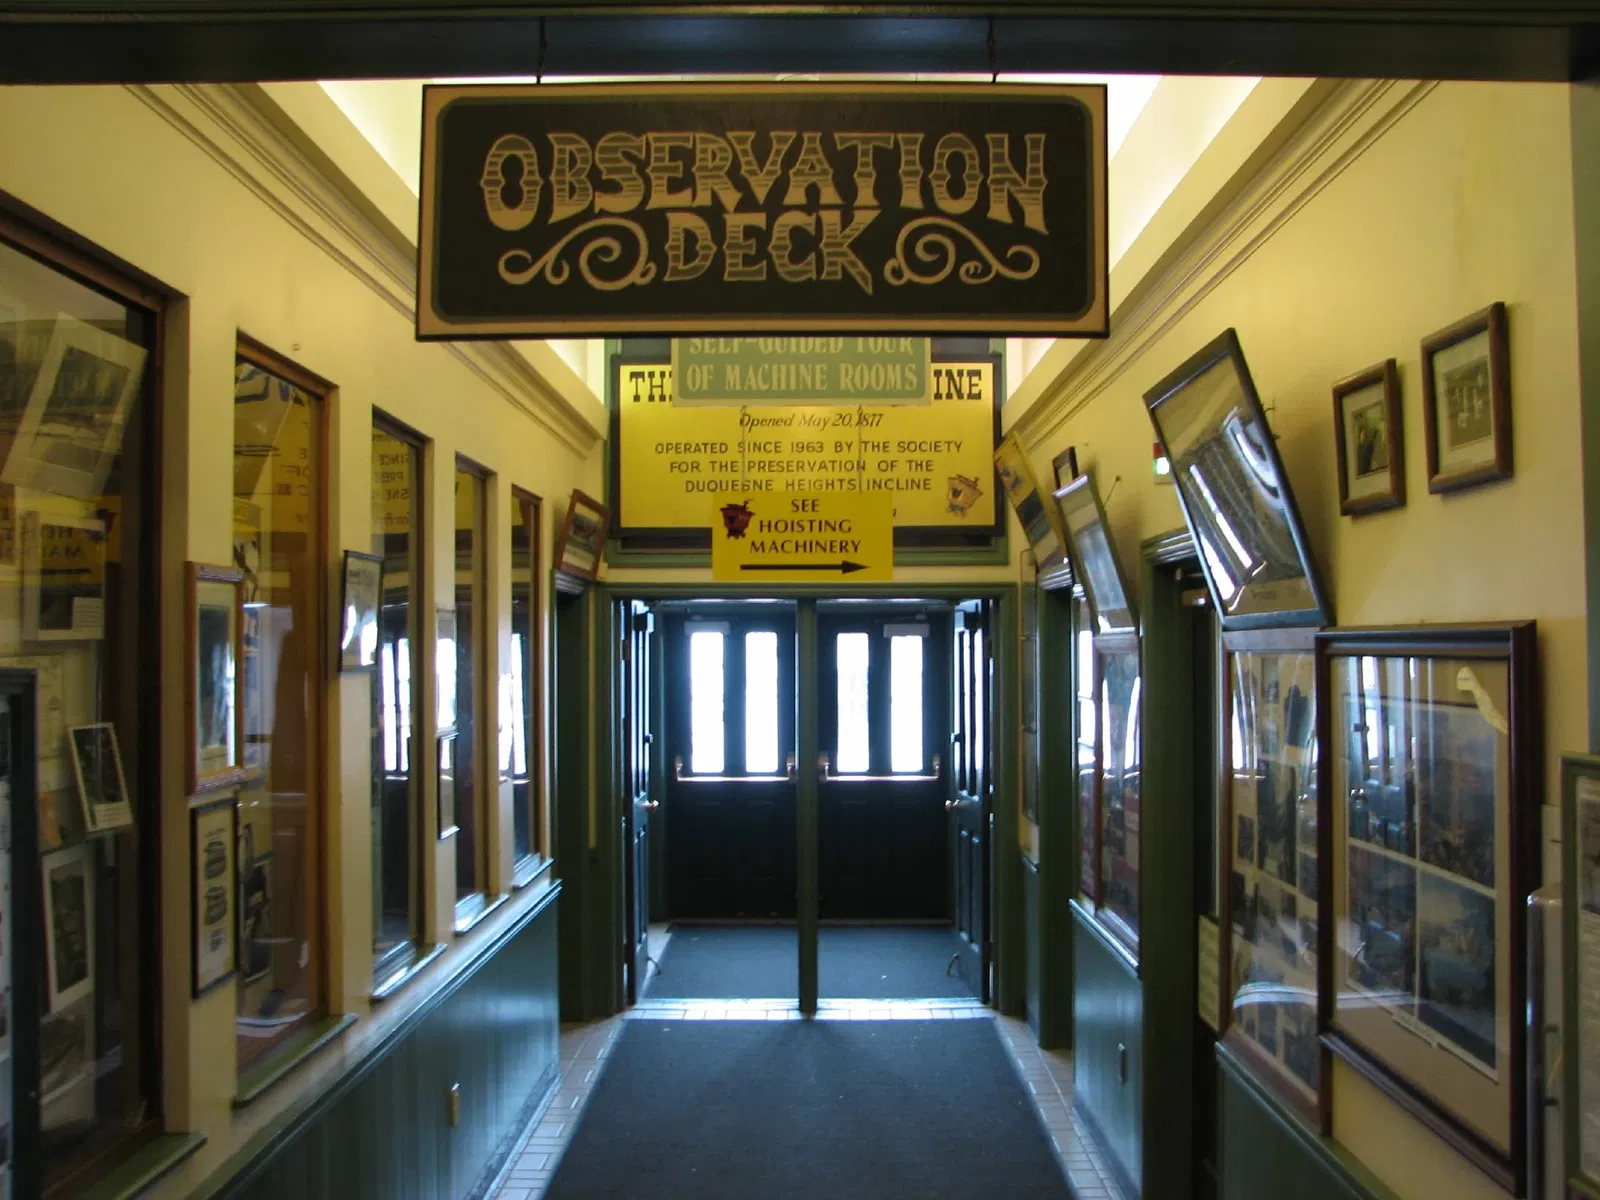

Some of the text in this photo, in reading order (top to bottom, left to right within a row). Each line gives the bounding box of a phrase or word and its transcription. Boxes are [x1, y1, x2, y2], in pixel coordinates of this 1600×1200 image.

[480, 131, 1049, 234] OBSERVATION
[664, 208, 880, 295] DECK
[688, 337, 914, 354] SELF-GUIDED TOUR
[686, 363, 918, 391] OF MACHINE ROOMS
[629, 371, 672, 402] TH
[739, 412, 796, 432] Opened
[798, 412, 831, 432] May
[655, 440, 962, 455] OPERATED SINCE 1963 BY THE SOCIETY
[669, 459, 934, 473] FOR THE PRESERVATION OF THE
[684, 477, 932, 493] DUQUESNE HEIGHTS INCLINE
[790, 499, 820, 513] SEE
[759, 519, 852, 534] HOISTING
[750, 539, 861, 555] MACHINERY
